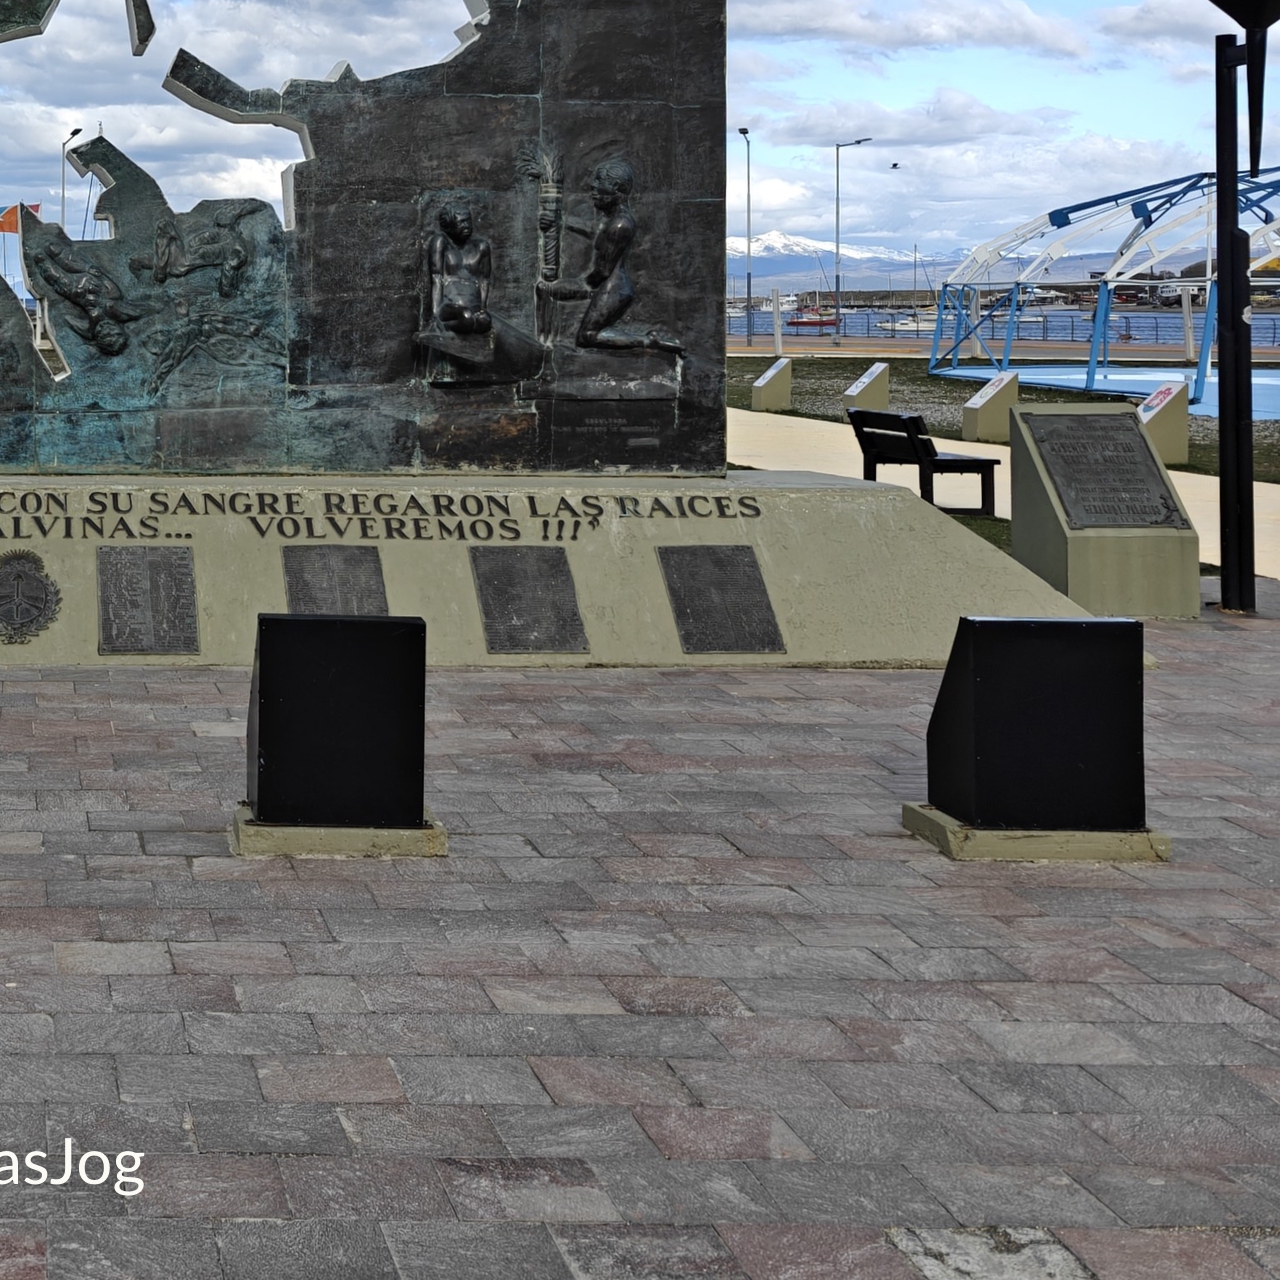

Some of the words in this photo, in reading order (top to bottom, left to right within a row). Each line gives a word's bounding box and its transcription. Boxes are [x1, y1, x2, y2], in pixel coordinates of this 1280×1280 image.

[87, 491, 134, 515] SU
[149, 491, 306, 516] SANGRE
[323, 492, 512, 517] REGARON
[527, 494, 605, 518] LAS
[618, 494, 762, 519] RAICES
[246, 515, 521, 541] VOLVEREMOS
